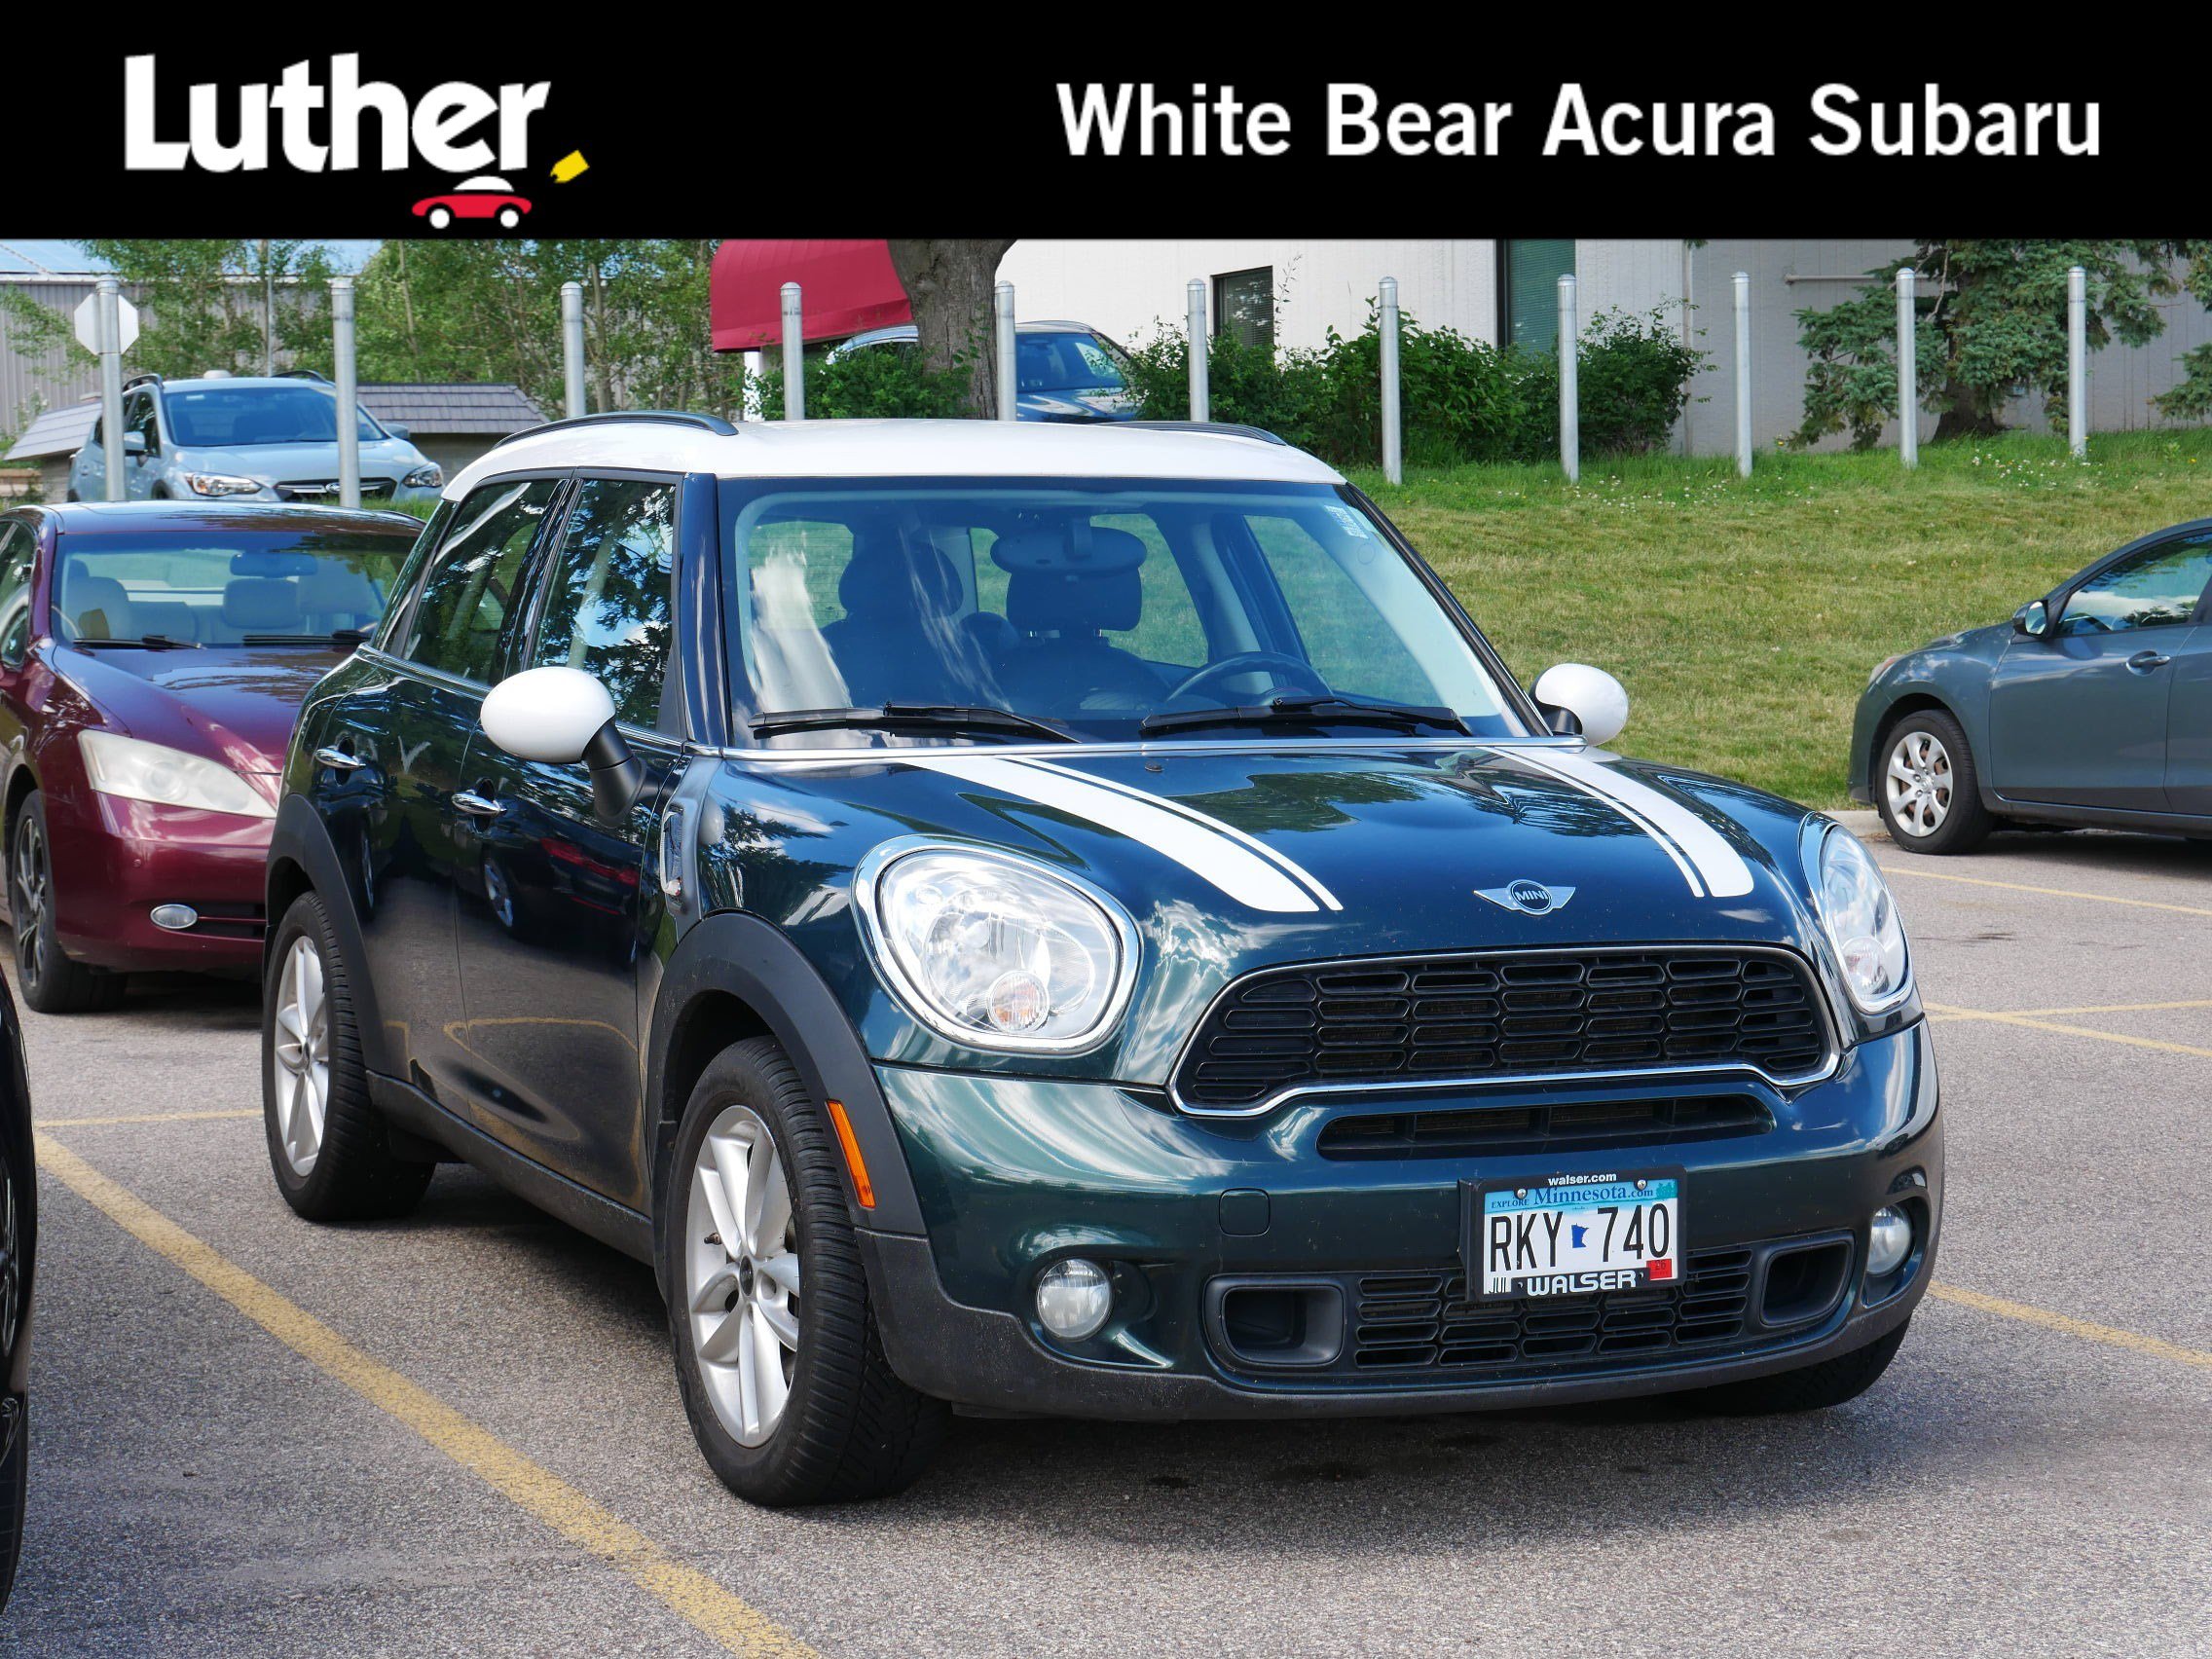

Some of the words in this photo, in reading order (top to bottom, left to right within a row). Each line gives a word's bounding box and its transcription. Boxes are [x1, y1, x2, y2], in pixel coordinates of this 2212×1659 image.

[1515, 890, 1549, 901] MINI
[1548, 1173, 1617, 1186] walser.com
[1533, 1186, 1654, 1204] Minnesota.com
[1491, 1211, 1564, 1272] RKY
[1597, 1202, 1670, 1263] 740
[1527, 1270, 1637, 1297] WALSER
